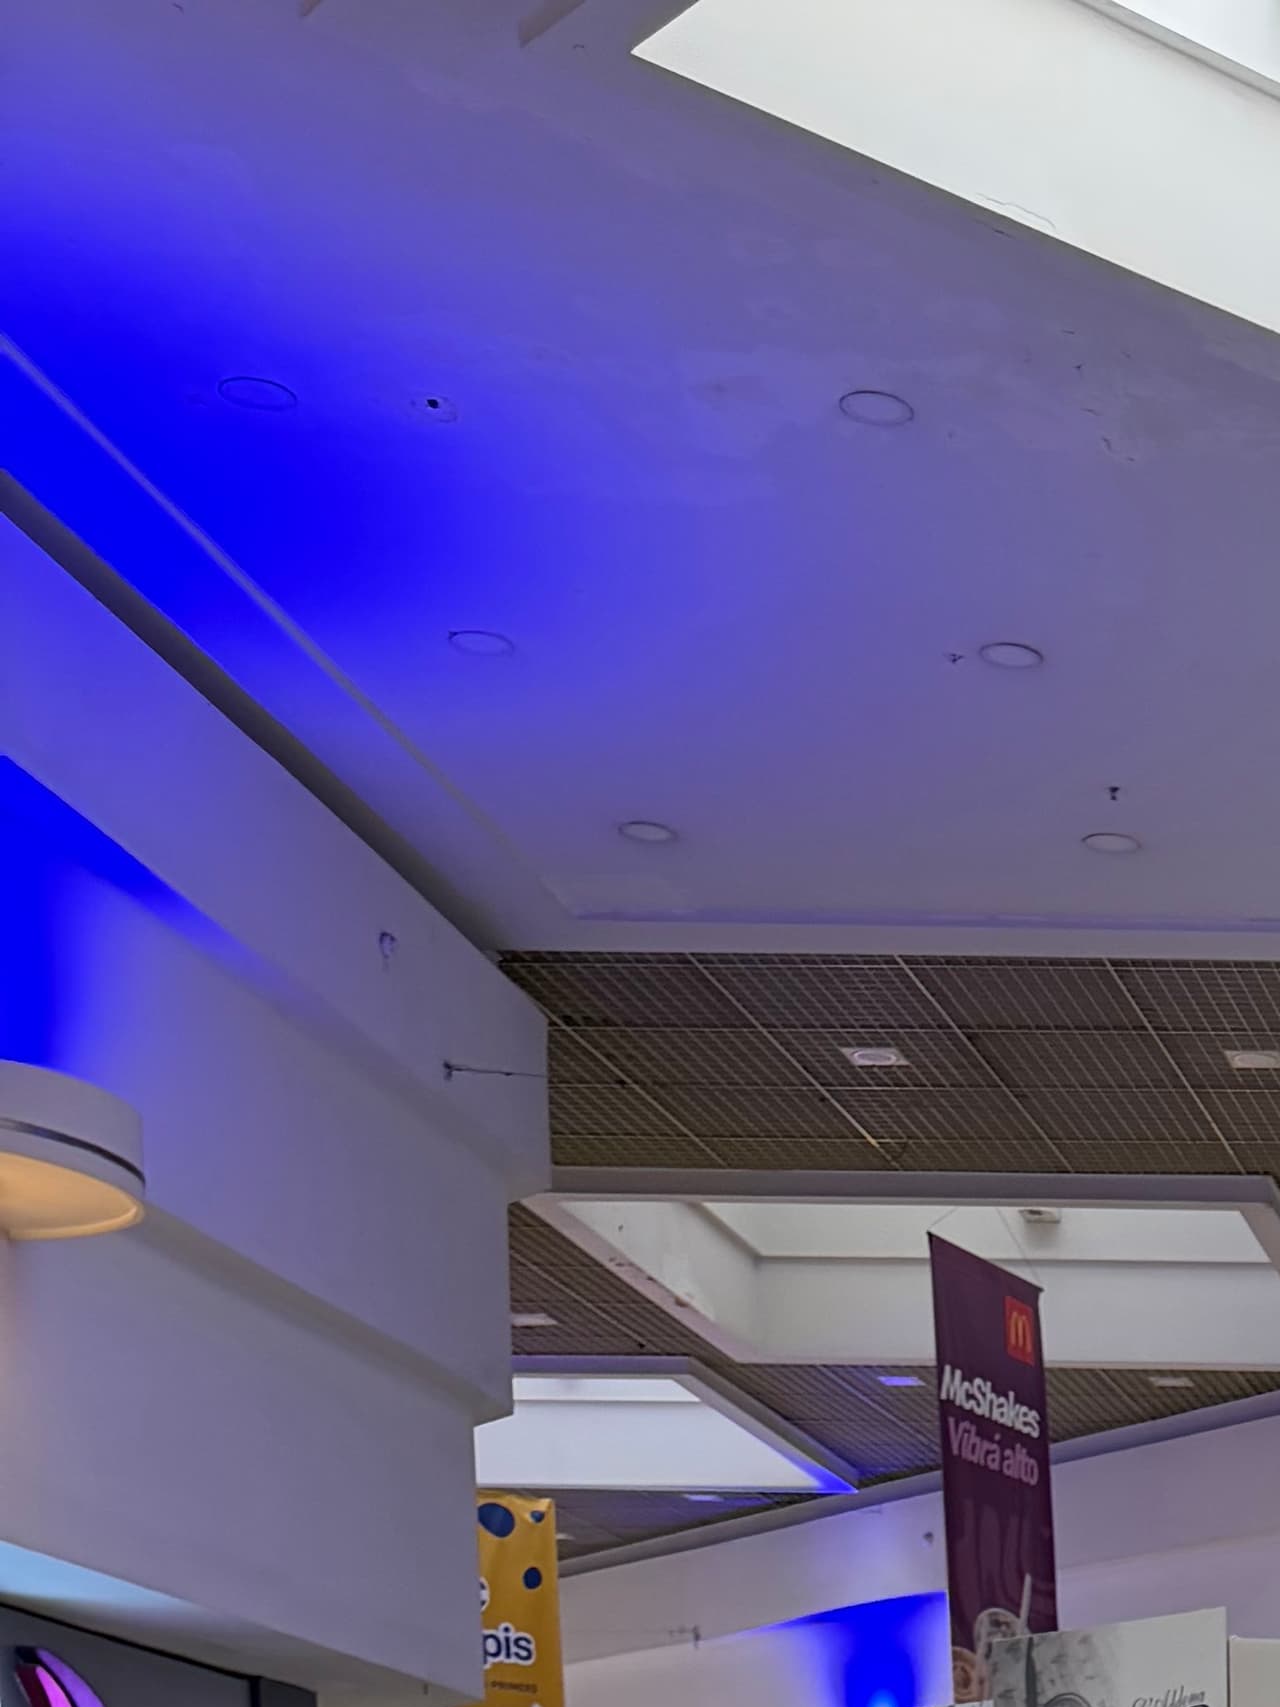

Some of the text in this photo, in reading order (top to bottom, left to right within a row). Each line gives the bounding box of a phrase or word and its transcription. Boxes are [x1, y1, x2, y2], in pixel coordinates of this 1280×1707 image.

[940, 1364, 1041, 1439] McShakes
[948, 1416, 1039, 1486] Vibrá alto
